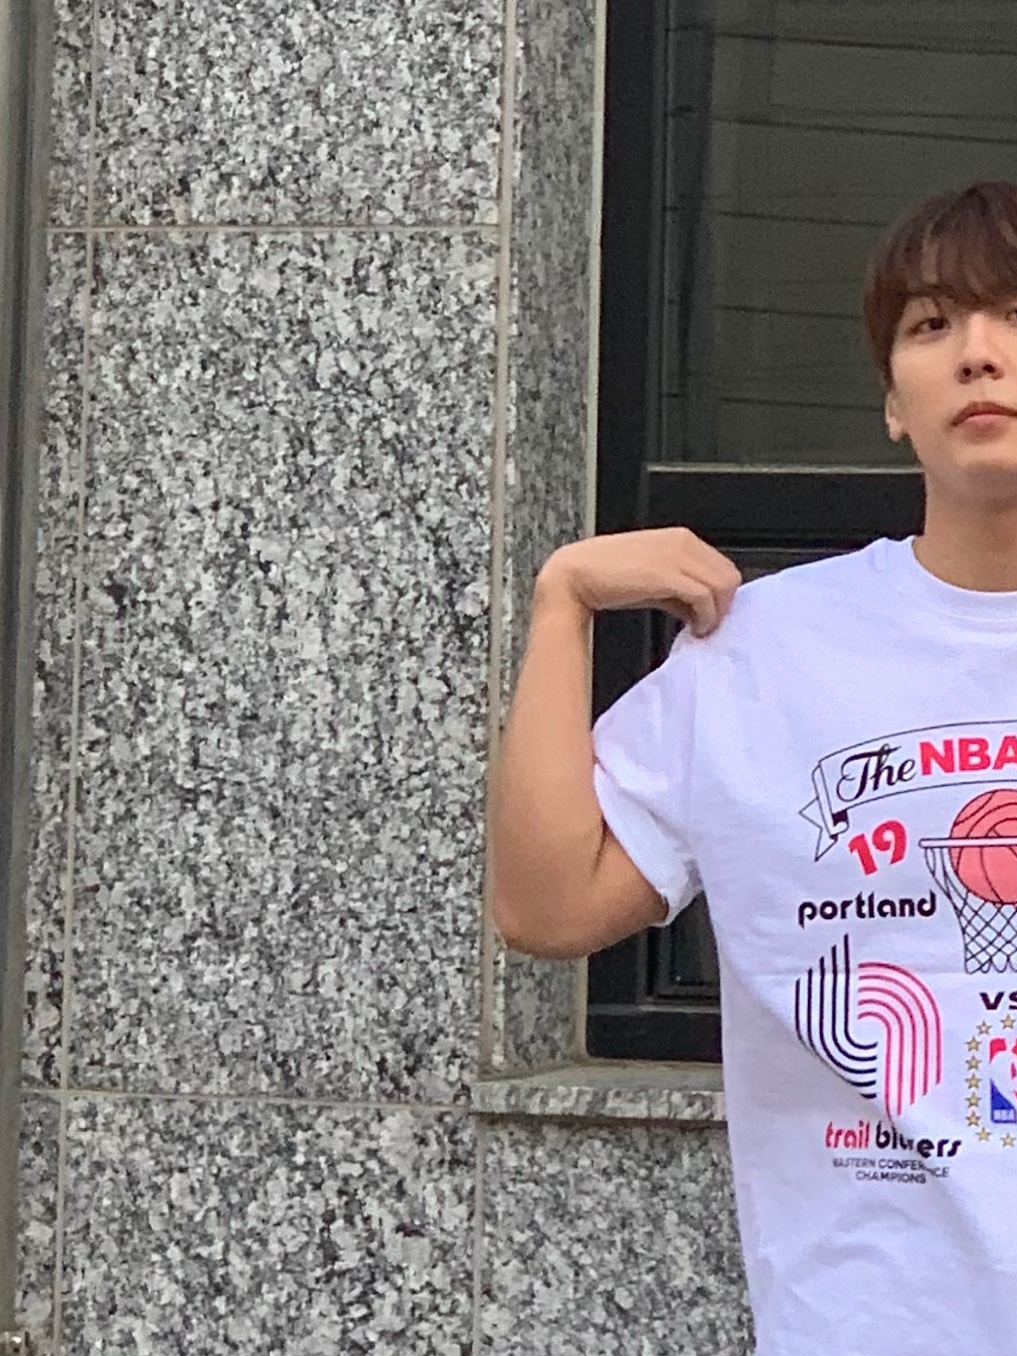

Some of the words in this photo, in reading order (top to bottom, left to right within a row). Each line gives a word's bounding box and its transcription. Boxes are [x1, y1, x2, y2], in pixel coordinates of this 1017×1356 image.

[836, 743, 919, 802] The
[848, 820, 908, 876] 19
[798, 891, 938, 929] portland
[825, 1120, 870, 1149] trail
[855, 1170, 927, 1184] CHAMPIONS
